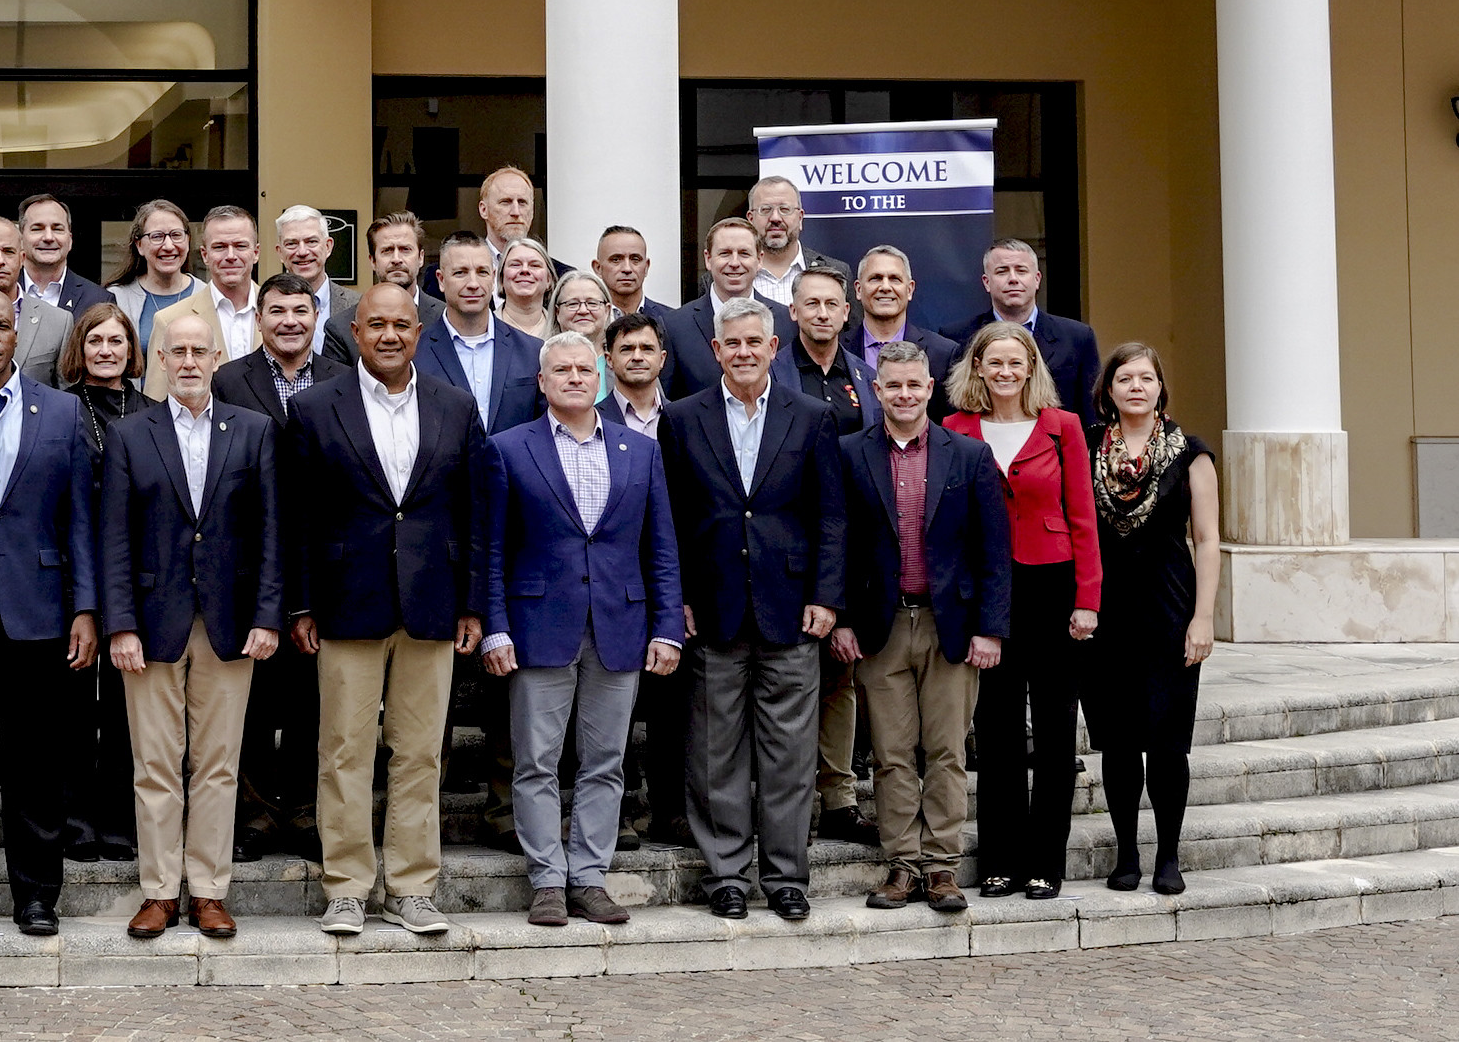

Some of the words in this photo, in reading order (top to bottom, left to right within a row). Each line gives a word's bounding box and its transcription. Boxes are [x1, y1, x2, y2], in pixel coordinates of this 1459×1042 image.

[800, 160, 949, 186] WELCOME
[841, 195, 867, 211] TO
[870, 194, 906, 210] THE
